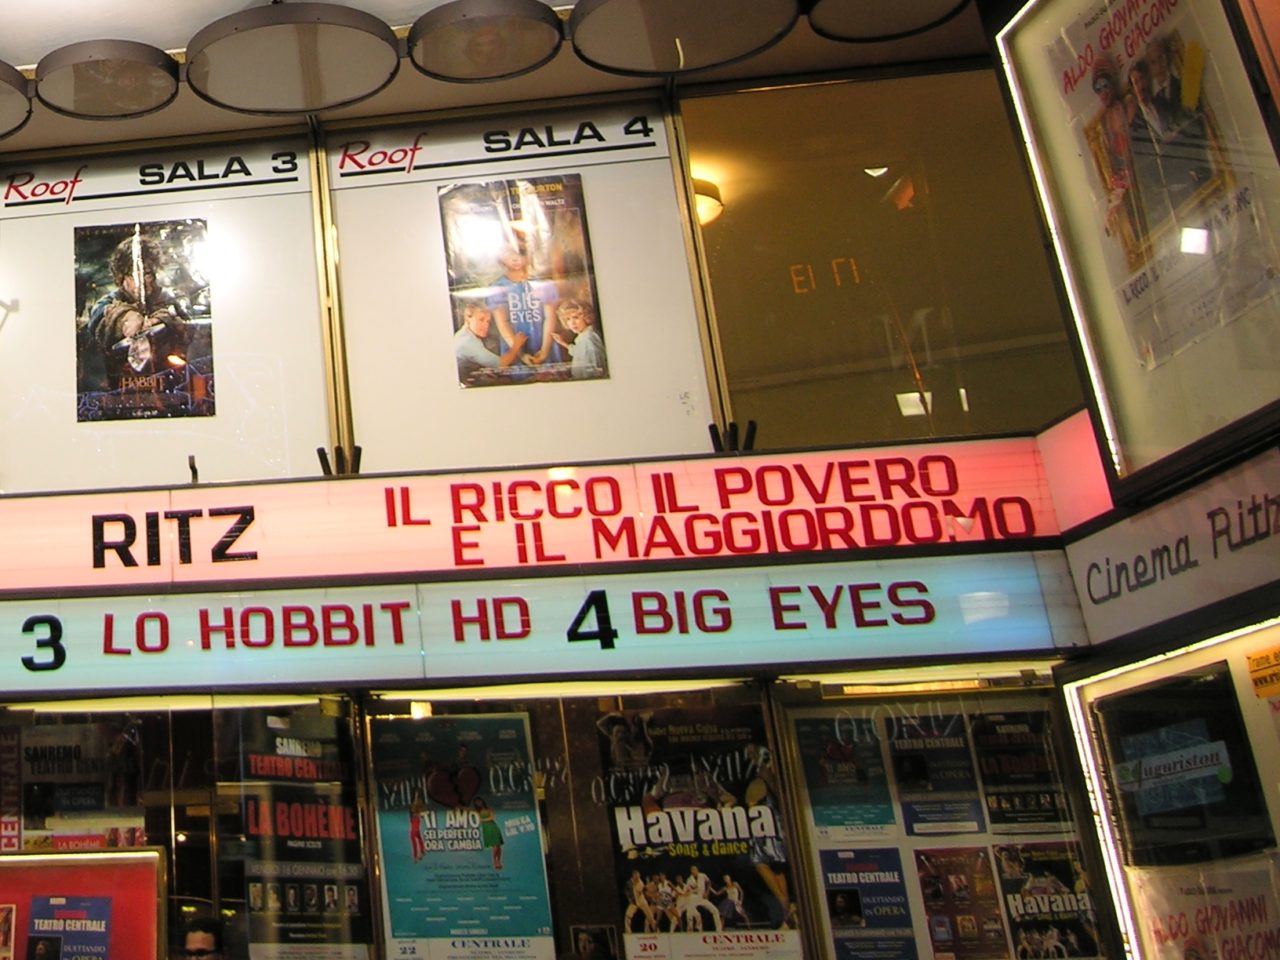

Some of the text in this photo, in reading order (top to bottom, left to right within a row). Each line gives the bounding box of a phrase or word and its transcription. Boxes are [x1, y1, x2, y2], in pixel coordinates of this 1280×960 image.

[1061, 43, 1094, 95] ALDO
[338, 116, 654, 174] Roof SALA 4
[4, 150, 298, 205] Roof SALA 3
[507, 291, 542, 324] BIG EYES
[120, 375, 166, 393] HOBBIT
[383, 454, 959, 528] IL RICCO IL POVERO
[91, 504, 260, 570] RITZ
[452, 496, 1036, 566] E IL MAGGIORDOMO
[1087, 534, 1200, 605] Cinema
[20, 614, 67, 673] 3
[102, 611, 169, 656] LO
[199, 601, 412, 651] HOBBIT
[450, 596, 531, 642] HD
[564, 589, 619, 650] 4
[632, 589, 731, 635] BIG
[770, 581, 936, 630] EYES
[24, 744, 81, 764] SANREMO
[248, 754, 294, 777] TEATRO
[247, 799, 358, 841] LA BOHÈME
[420, 810, 480, 829] TI AMO
[614, 804, 776, 846] Havana
[423, 828, 479, 840] SEI PERFETTO
[424, 839, 483, 851] ORA CAMBIA
[668, 842, 698, 858] song
[711, 839, 749, 856] dance
[827, 871, 901, 885] TEATRO CENTRALE
[872, 904, 906, 917] OPERA
[1006, 890, 1090, 916] Havana
[1195, 894, 1268, 935] GIOVANNI
[34, 919, 107, 933] TEATRO CENTRALE
[63, 944, 106, 954] DUETTANDO
[451, 940, 531, 949] CENTRALE
[639, 942, 658, 952] 20
[702, 933, 786, 944] CENTRALE
